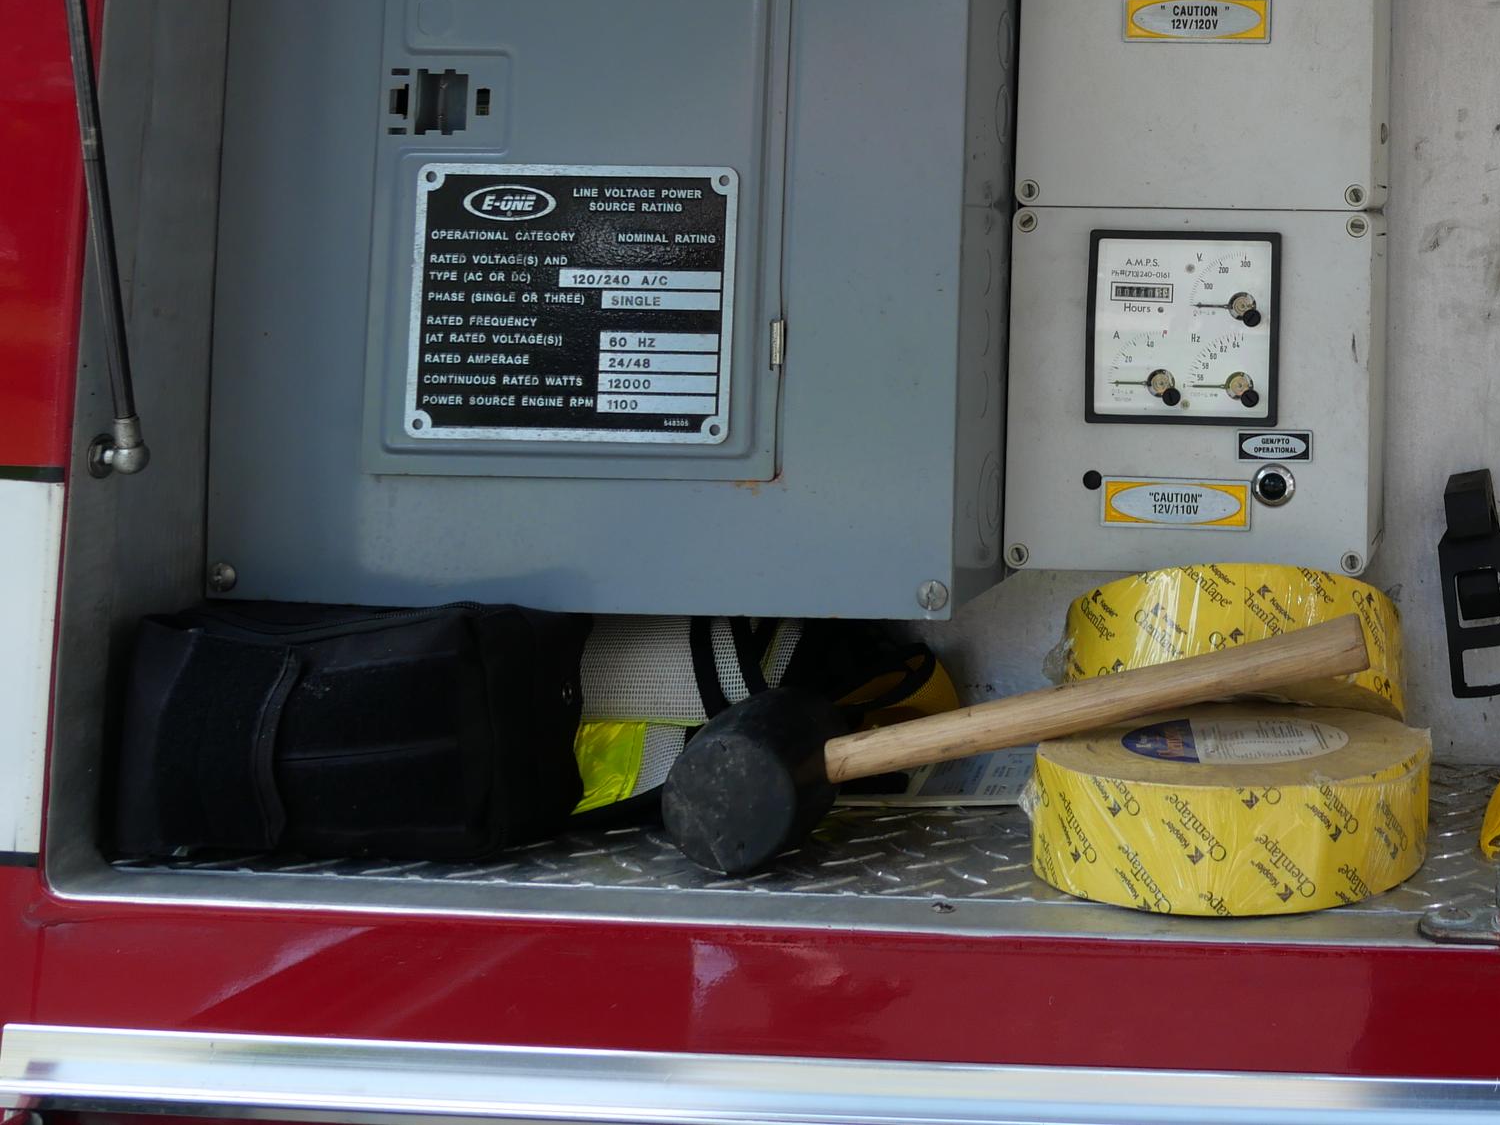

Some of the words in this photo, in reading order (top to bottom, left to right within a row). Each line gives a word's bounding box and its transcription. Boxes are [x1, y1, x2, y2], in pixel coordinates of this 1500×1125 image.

[1172, 5, 1218, 17] CAUTION
[1171, 19, 1219, 30] 12V/120V
[573, 188, 599, 197] LINE
[604, 188, 656, 198] VOLTAGE
[661, 189, 703, 199] POWER
[481, 194, 537, 211] E-ONE
[589, 202, 636, 212] SOURCE
[641, 203, 683, 212] RATING
[431, 229, 509, 240] OPERATIONAL
[515, 231, 576, 241] CATEGORY
[618, 233, 669, 243] NOMINAL
[674, 234, 716, 244] RATING
[430, 254, 467, 264] RATED
[472, 255, 539, 266] VOLTAGE(S)
[544, 256, 568, 265] AND
[1125, 258, 1160, 268] A.M.P.S.
[1240, 260, 1251, 268] 300
[1218, 266, 1229, 274] 200
[429, 271, 458, 281] TYPE
[463, 272, 483, 283] (AC
[489, 273, 505, 282] OR
[511, 273, 531, 284] DC)
[572, 274, 630, 285] 120/240
[641, 275, 668, 286] A/C
[1204, 282, 1213, 290] 100
[427, 292, 465, 302] PHASE
[471, 292, 516, 303] (SINGLE
[522, 293, 538, 303] OR
[544, 293, 585, 305] THREE)
[611, 296, 661, 306] SINGLE
[1123, 303, 1151, 313] Hours
[426, 315, 463, 325] RATED
[469, 317, 538, 327] FREQUENCY
[425, 333, 444, 344] [AT
[450, 333, 486, 343] RATED
[492, 334, 563, 346] VOLTAGE(S)]
[1112, 330, 1120, 339] A
[1191, 333, 1200, 342] Hz
[609, 337, 627, 348] 60
[638, 337, 656, 348] HZ
[1219, 345, 1227, 353] 62
[424, 354, 461, 363] RATED
[467, 355, 530, 365] AMPERAGE
[608, 357, 651, 369] 24/48
[423, 374, 497, 385] CONTINUOUS
[502, 376, 539, 386] RATED
[545, 377, 583, 387] WATTS
[607, 378, 651, 389] 12000
[422, 395, 463, 405] POWER
[469, 396, 515, 406] SOURCE
[521, 397, 564, 407] ENGINE
[569, 397, 594, 407] RPM
[607, 399, 638, 410] 1100
[1261, 437, 1290, 445] GEN/PTO
[1253, 446, 1297, 454] OPERATIONAL
[1152, 504, 1199, 515] 12V/110V
